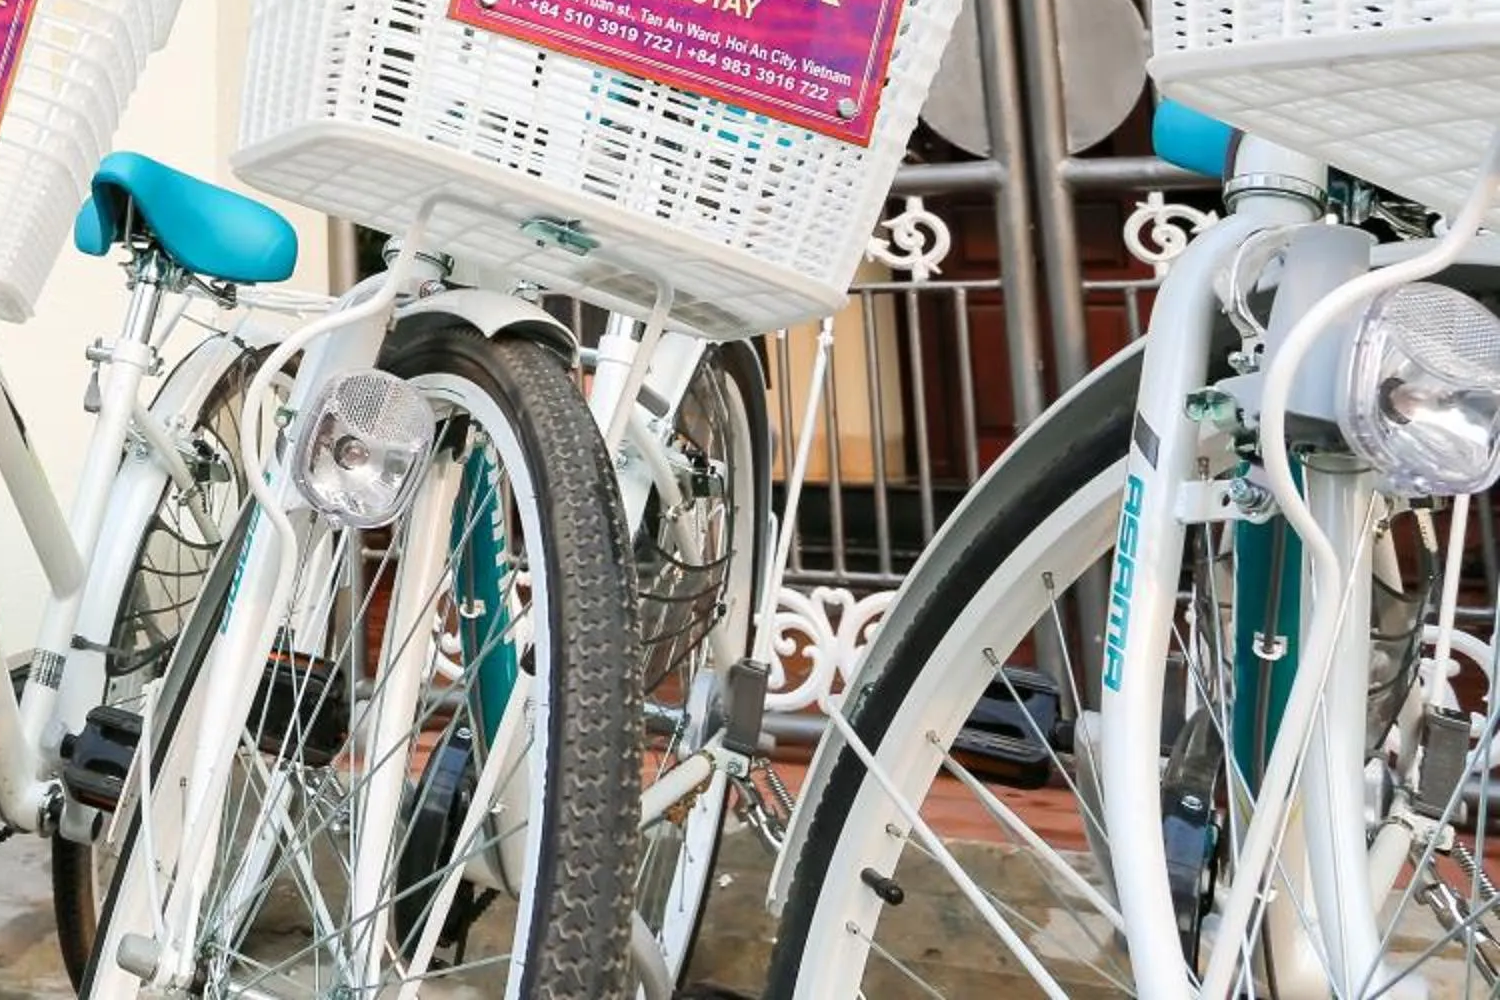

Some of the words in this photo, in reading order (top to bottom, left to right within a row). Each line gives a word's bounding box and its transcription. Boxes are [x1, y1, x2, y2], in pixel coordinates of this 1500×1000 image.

[530, 0, 559, 18] +84
[564, 8, 594, 28] 510
[598, 18, 639, 41] 3919
[644, 32, 673, 53] 722
[688, 48, 717, 66] +84
[721, 56, 751, 77] 983
[755, 67, 795, 90] 3916
[800, 80, 829, 101] 722
[641, 8, 663, 26] Tan
[664, 17, 684, 33] An
[686, 23, 721, 48] Ward,
[725, 36, 748, 53] Hoi
[748, 44, 768, 60] An
[770, 49, 797, 71] City,
[802, 59, 851, 85] Vietnam
[1101, 473, 1145, 694] ASAMA
